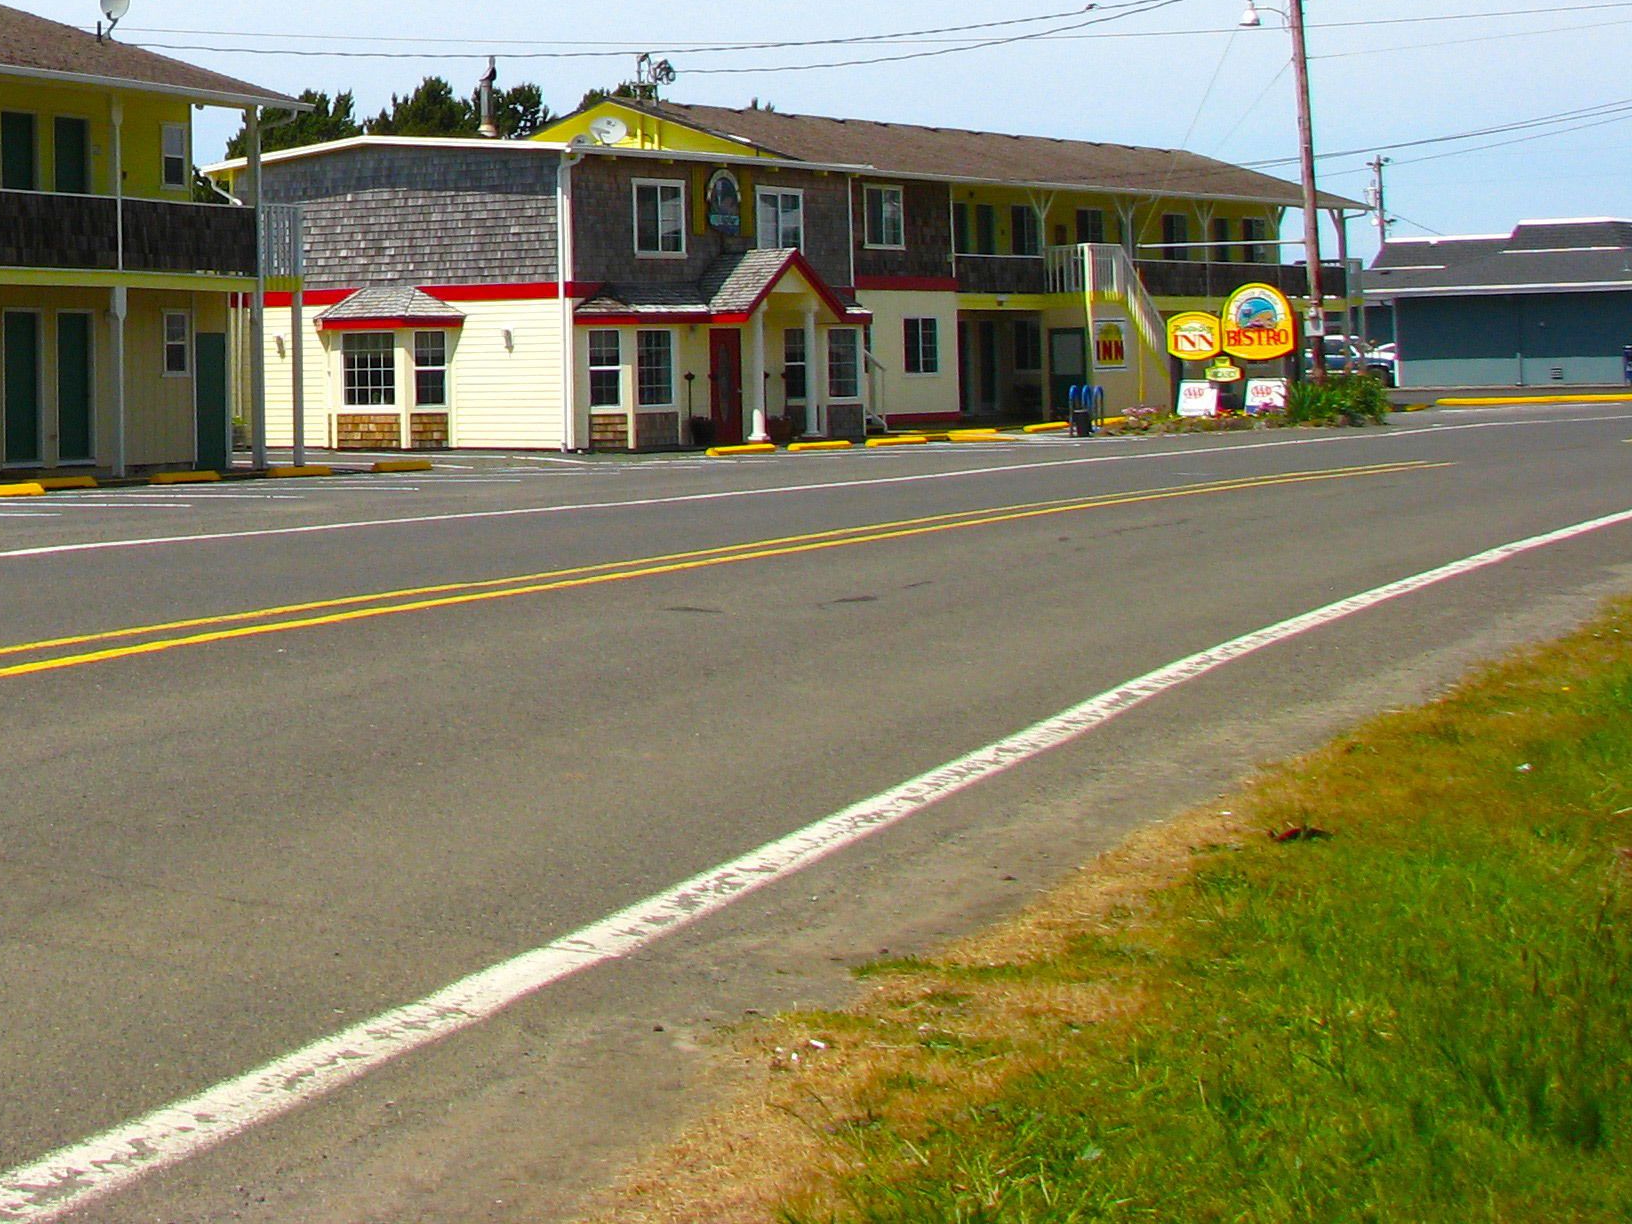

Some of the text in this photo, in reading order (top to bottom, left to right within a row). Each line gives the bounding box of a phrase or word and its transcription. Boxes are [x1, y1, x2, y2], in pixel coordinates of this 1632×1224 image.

[1173, 333, 1214, 351] INN
[1226, 328, 1289, 346] BISTRO
[1095, 340, 1124, 361] INN
